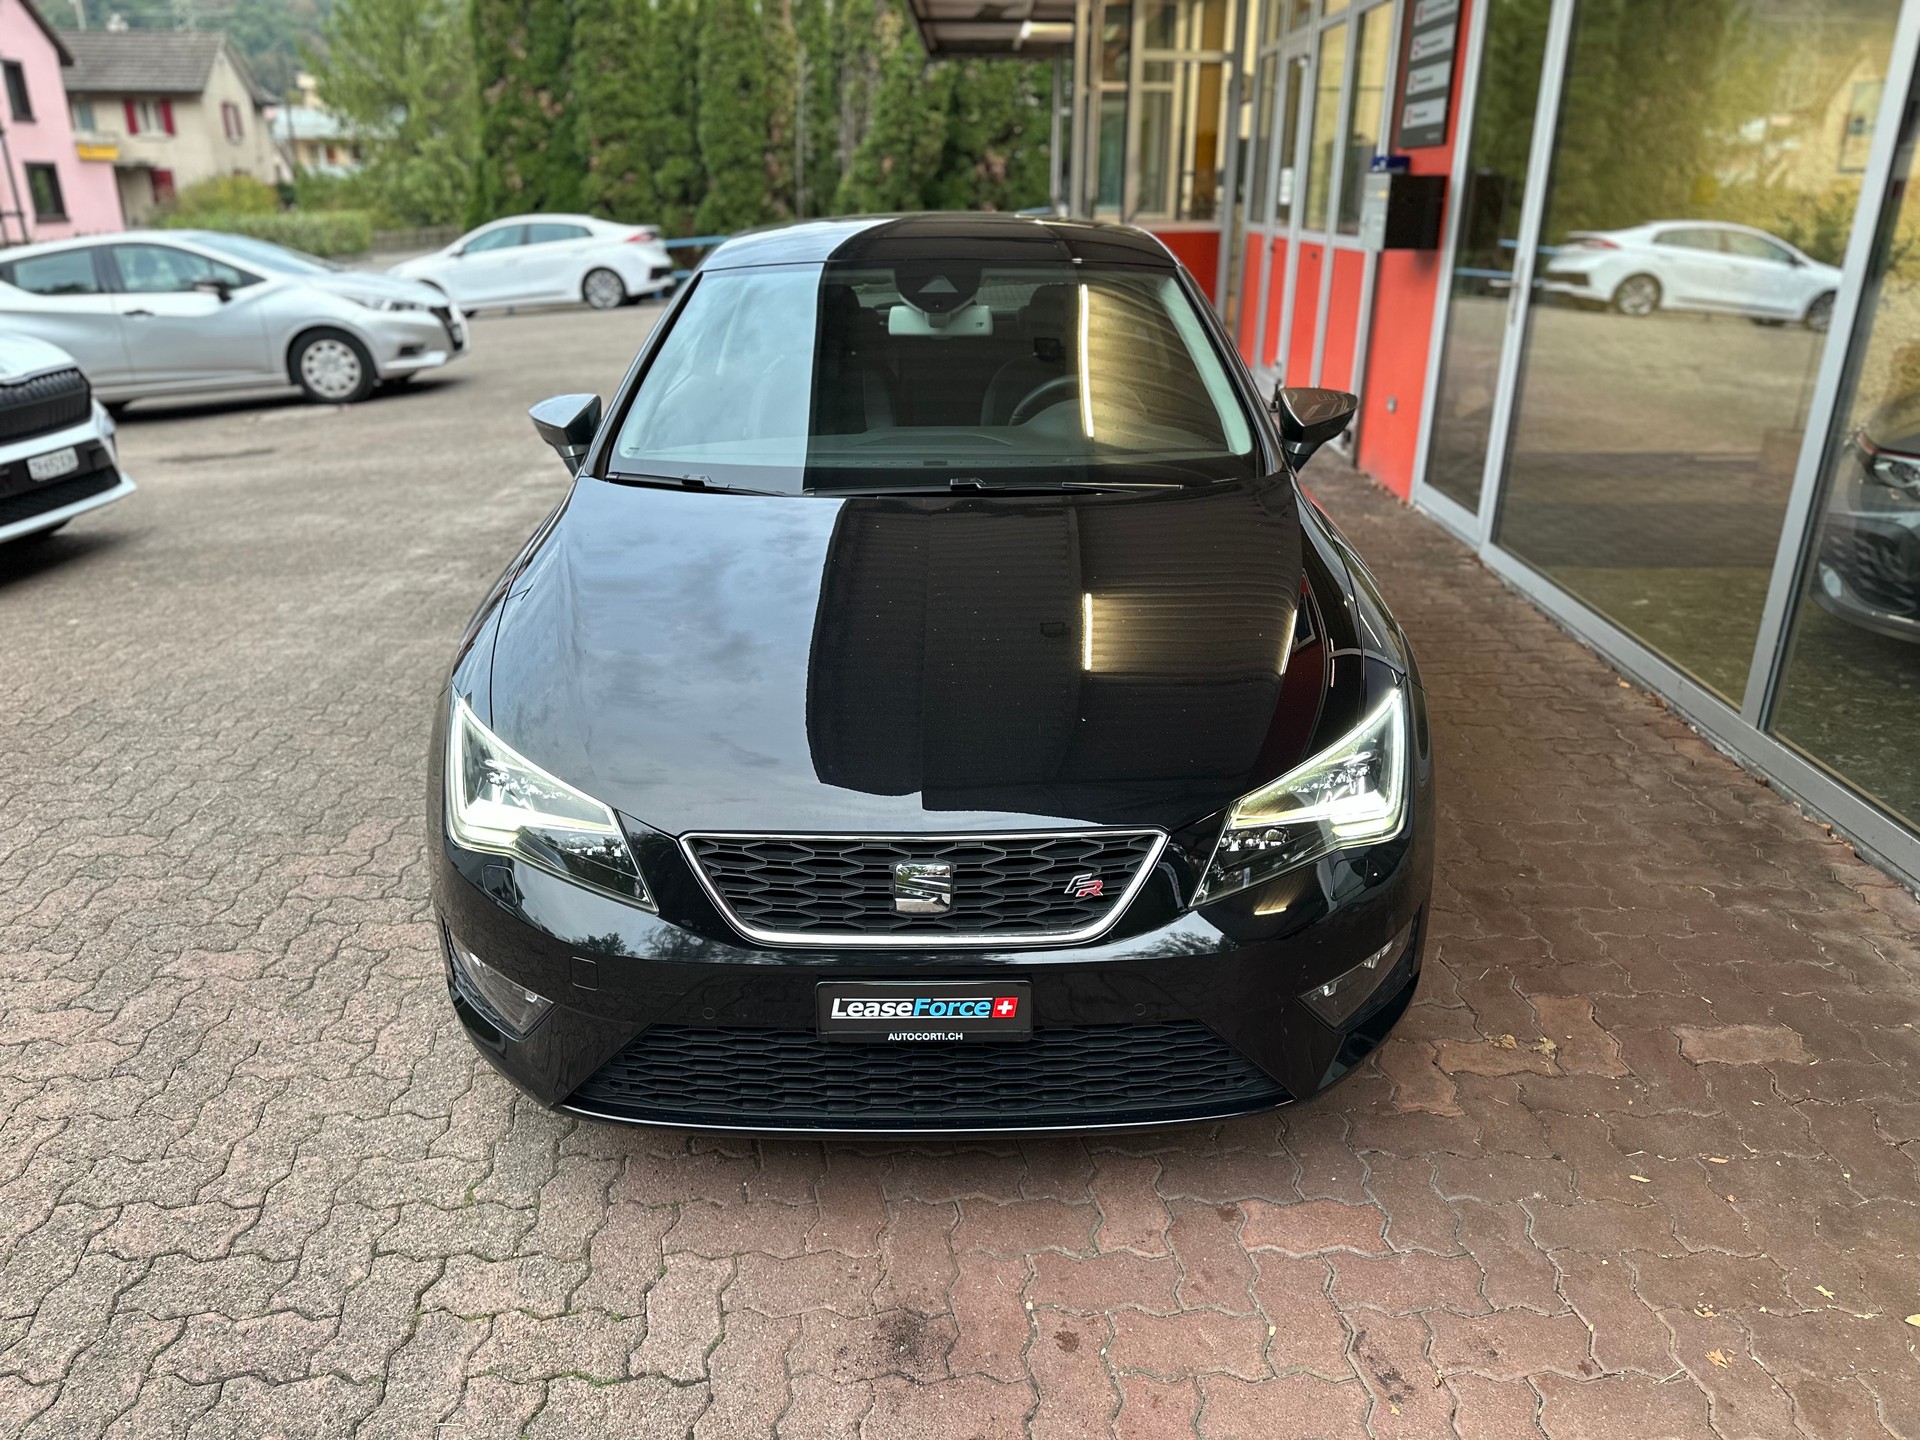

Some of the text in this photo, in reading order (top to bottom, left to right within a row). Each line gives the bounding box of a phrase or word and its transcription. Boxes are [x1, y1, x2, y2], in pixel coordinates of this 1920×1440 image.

[1064, 872, 1104, 898] FR
[831, 998, 991, 1018] LeaseForce
[887, 1032, 964, 1041] AUTOCORTI.CH
